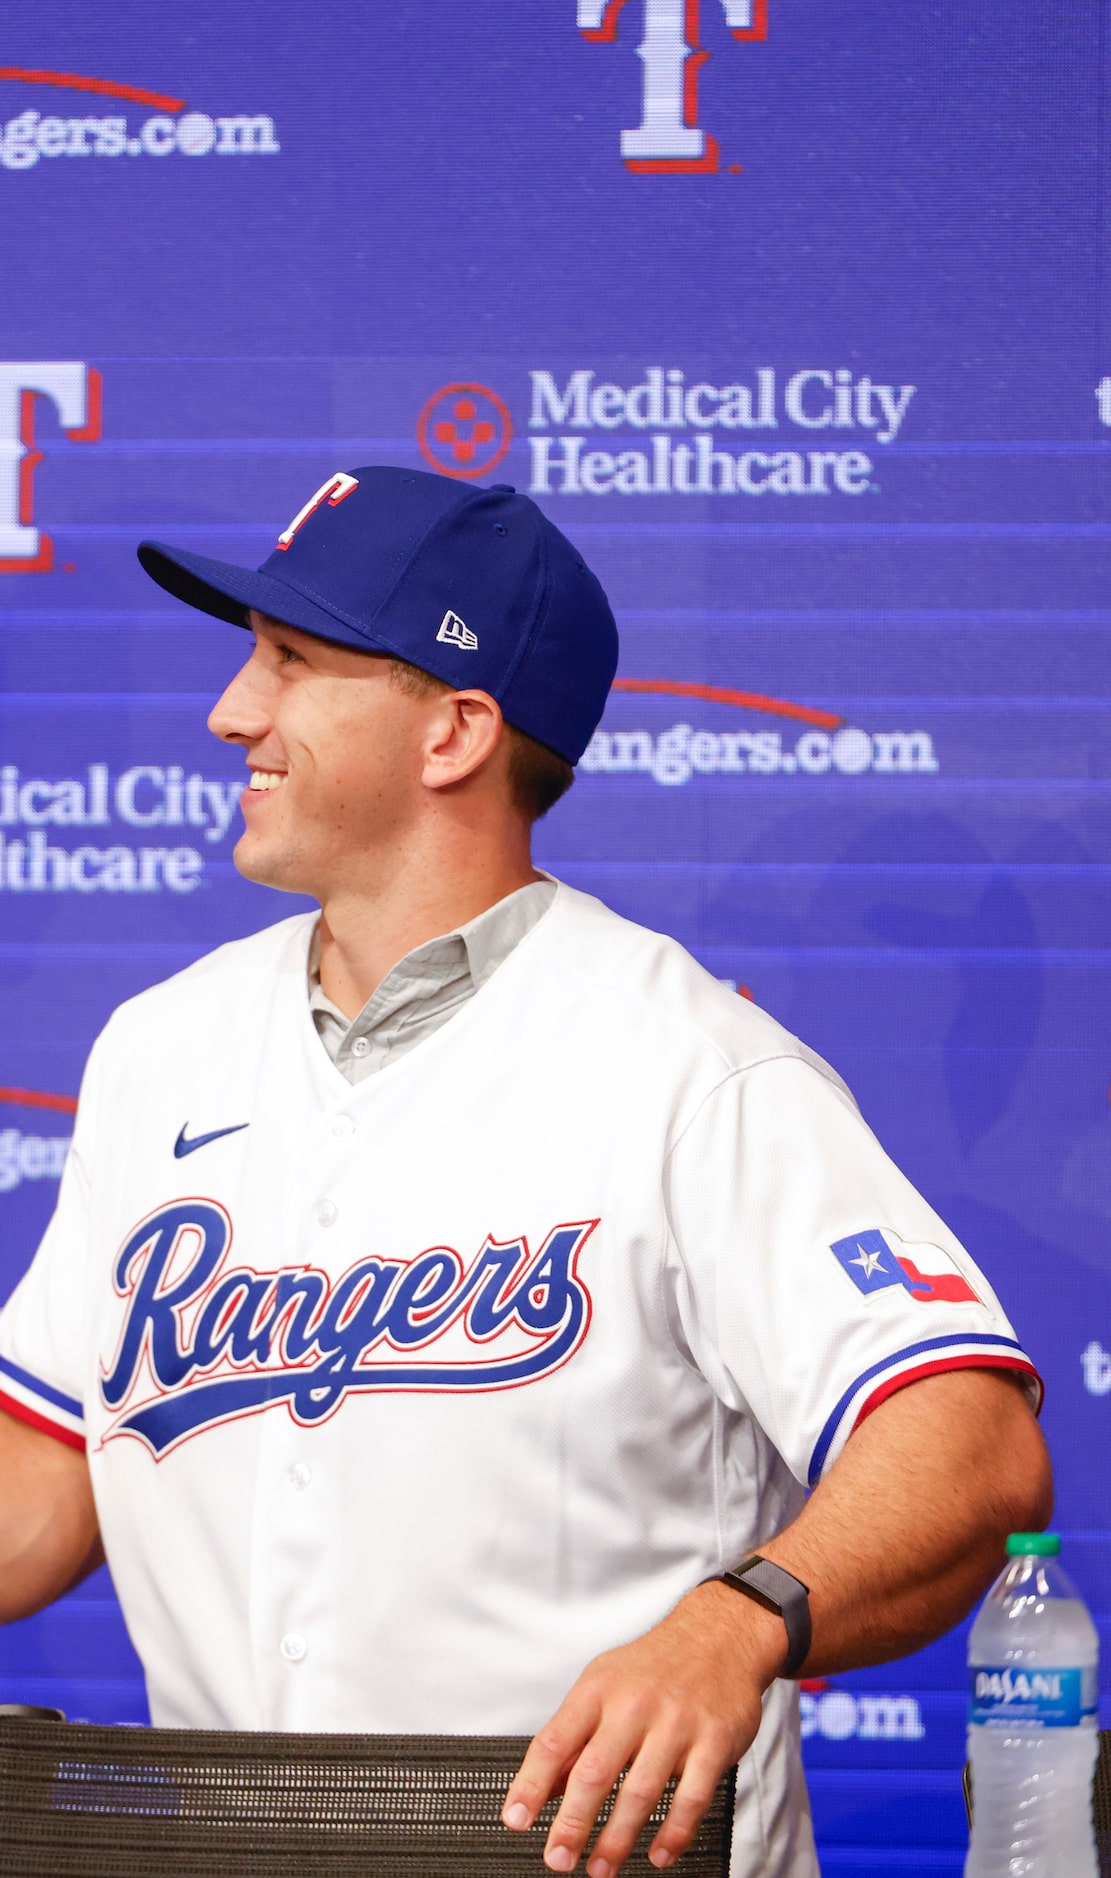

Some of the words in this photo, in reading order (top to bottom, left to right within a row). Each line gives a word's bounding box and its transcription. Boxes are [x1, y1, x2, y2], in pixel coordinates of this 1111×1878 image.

[528, 366, 779, 429] Medical
[784, 368, 917, 445] City
[528, 433, 873, 495] Healthcare
[116, 766, 244, 843] City
[94, 1196, 601, 1462] Rangers
